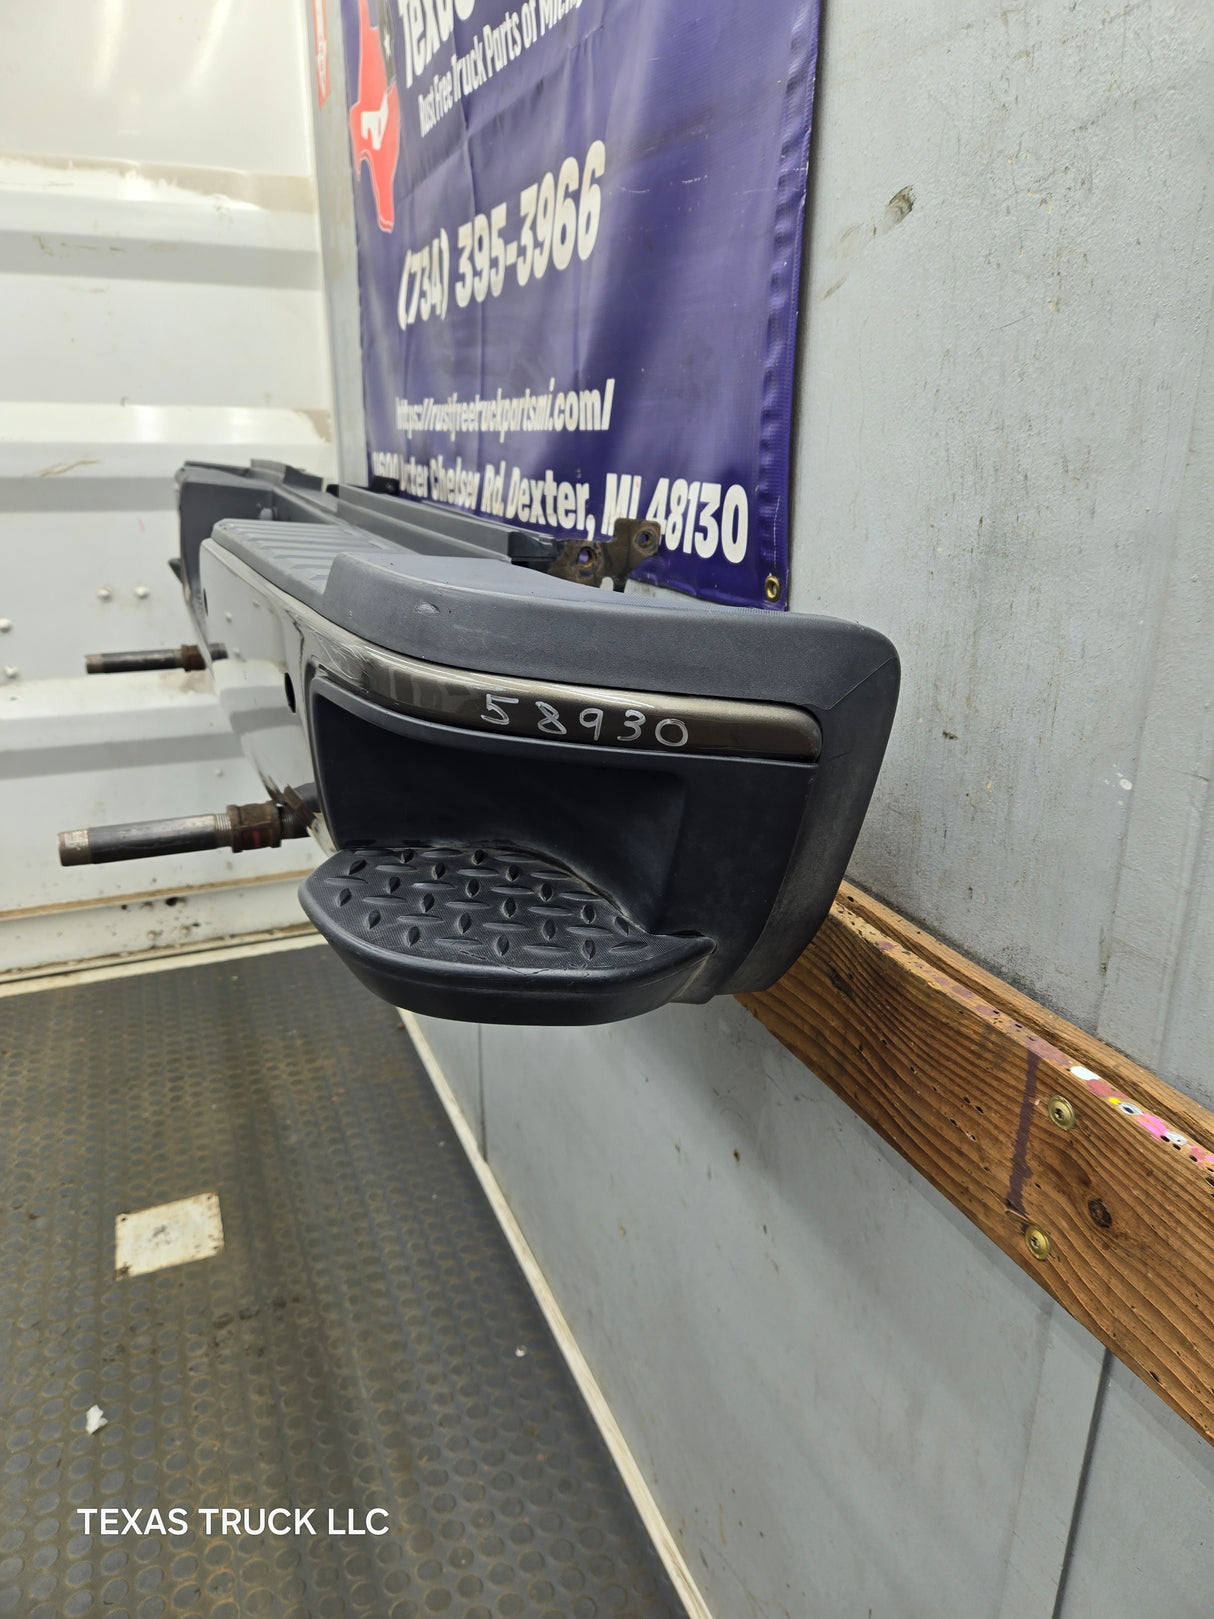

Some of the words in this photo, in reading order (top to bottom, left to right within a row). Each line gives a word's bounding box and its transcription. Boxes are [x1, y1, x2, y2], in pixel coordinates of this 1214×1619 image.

[433, 71, 453, 122] Free
[450, 35, 488, 103] Truck
[482, 12, 522, 78] Parts
[521, 0, 538, 48] of
[397, 228, 449, 331] (734)
[455, 139, 606, 308] 395-3966
[480, 460, 506, 517] Rd.
[505, 466, 596, 541] Dexter,
[601, 473, 642, 537] MI
[645, 477, 749, 564] 48130
[480, 693, 689, 747] 58930
